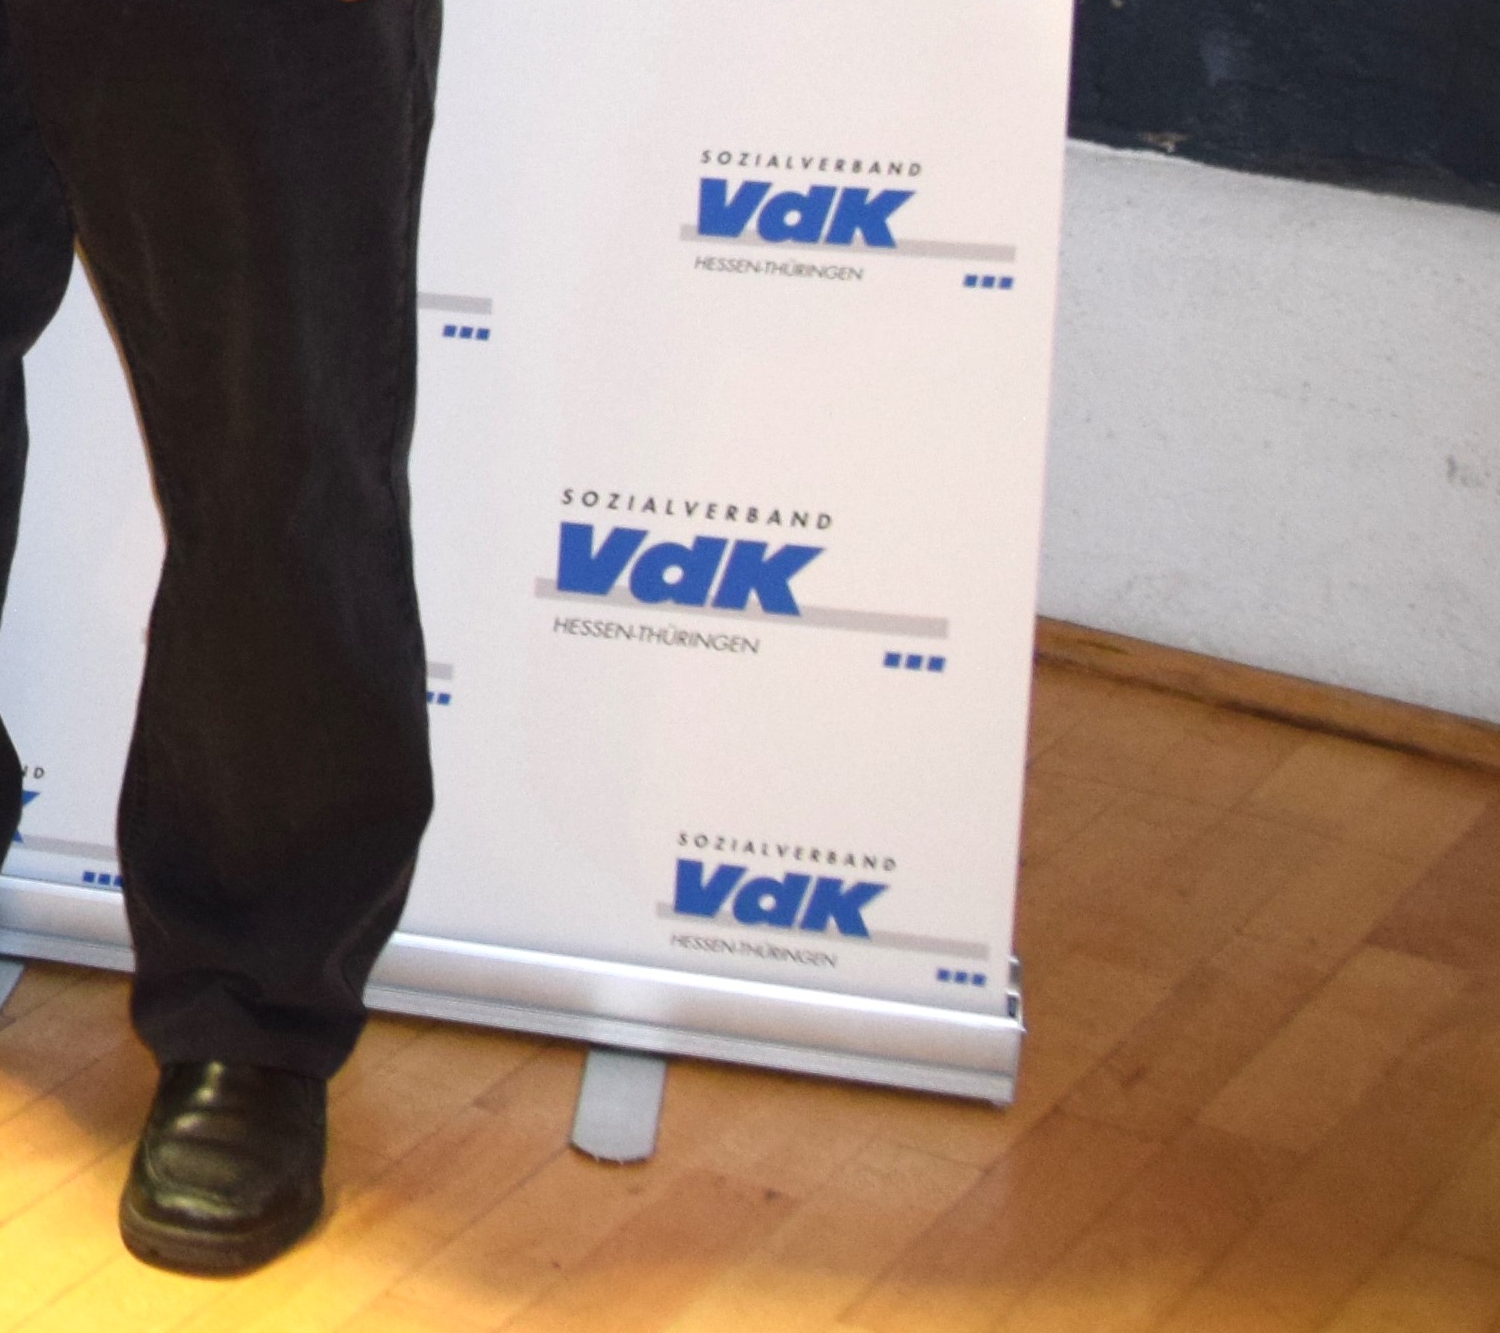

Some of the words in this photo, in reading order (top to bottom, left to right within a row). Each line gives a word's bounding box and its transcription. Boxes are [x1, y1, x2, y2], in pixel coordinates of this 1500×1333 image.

[701, 149, 922, 177] SOZIALVERBAND
[698, 177, 914, 247] VdK
[694, 256, 864, 281] HESSEN-THÜRINGEN
[560, 488, 833, 530] SOZIALVERBAND
[557, 522, 823, 615] VdK
[552, 617, 760, 655] HESSEN-THÜRINGEN
[676, 833, 897, 871] SOZIALVERBAND
[675, 859, 886, 937] VdK
[669, 934, 836, 968] HESSEN-THÜRINGEN
